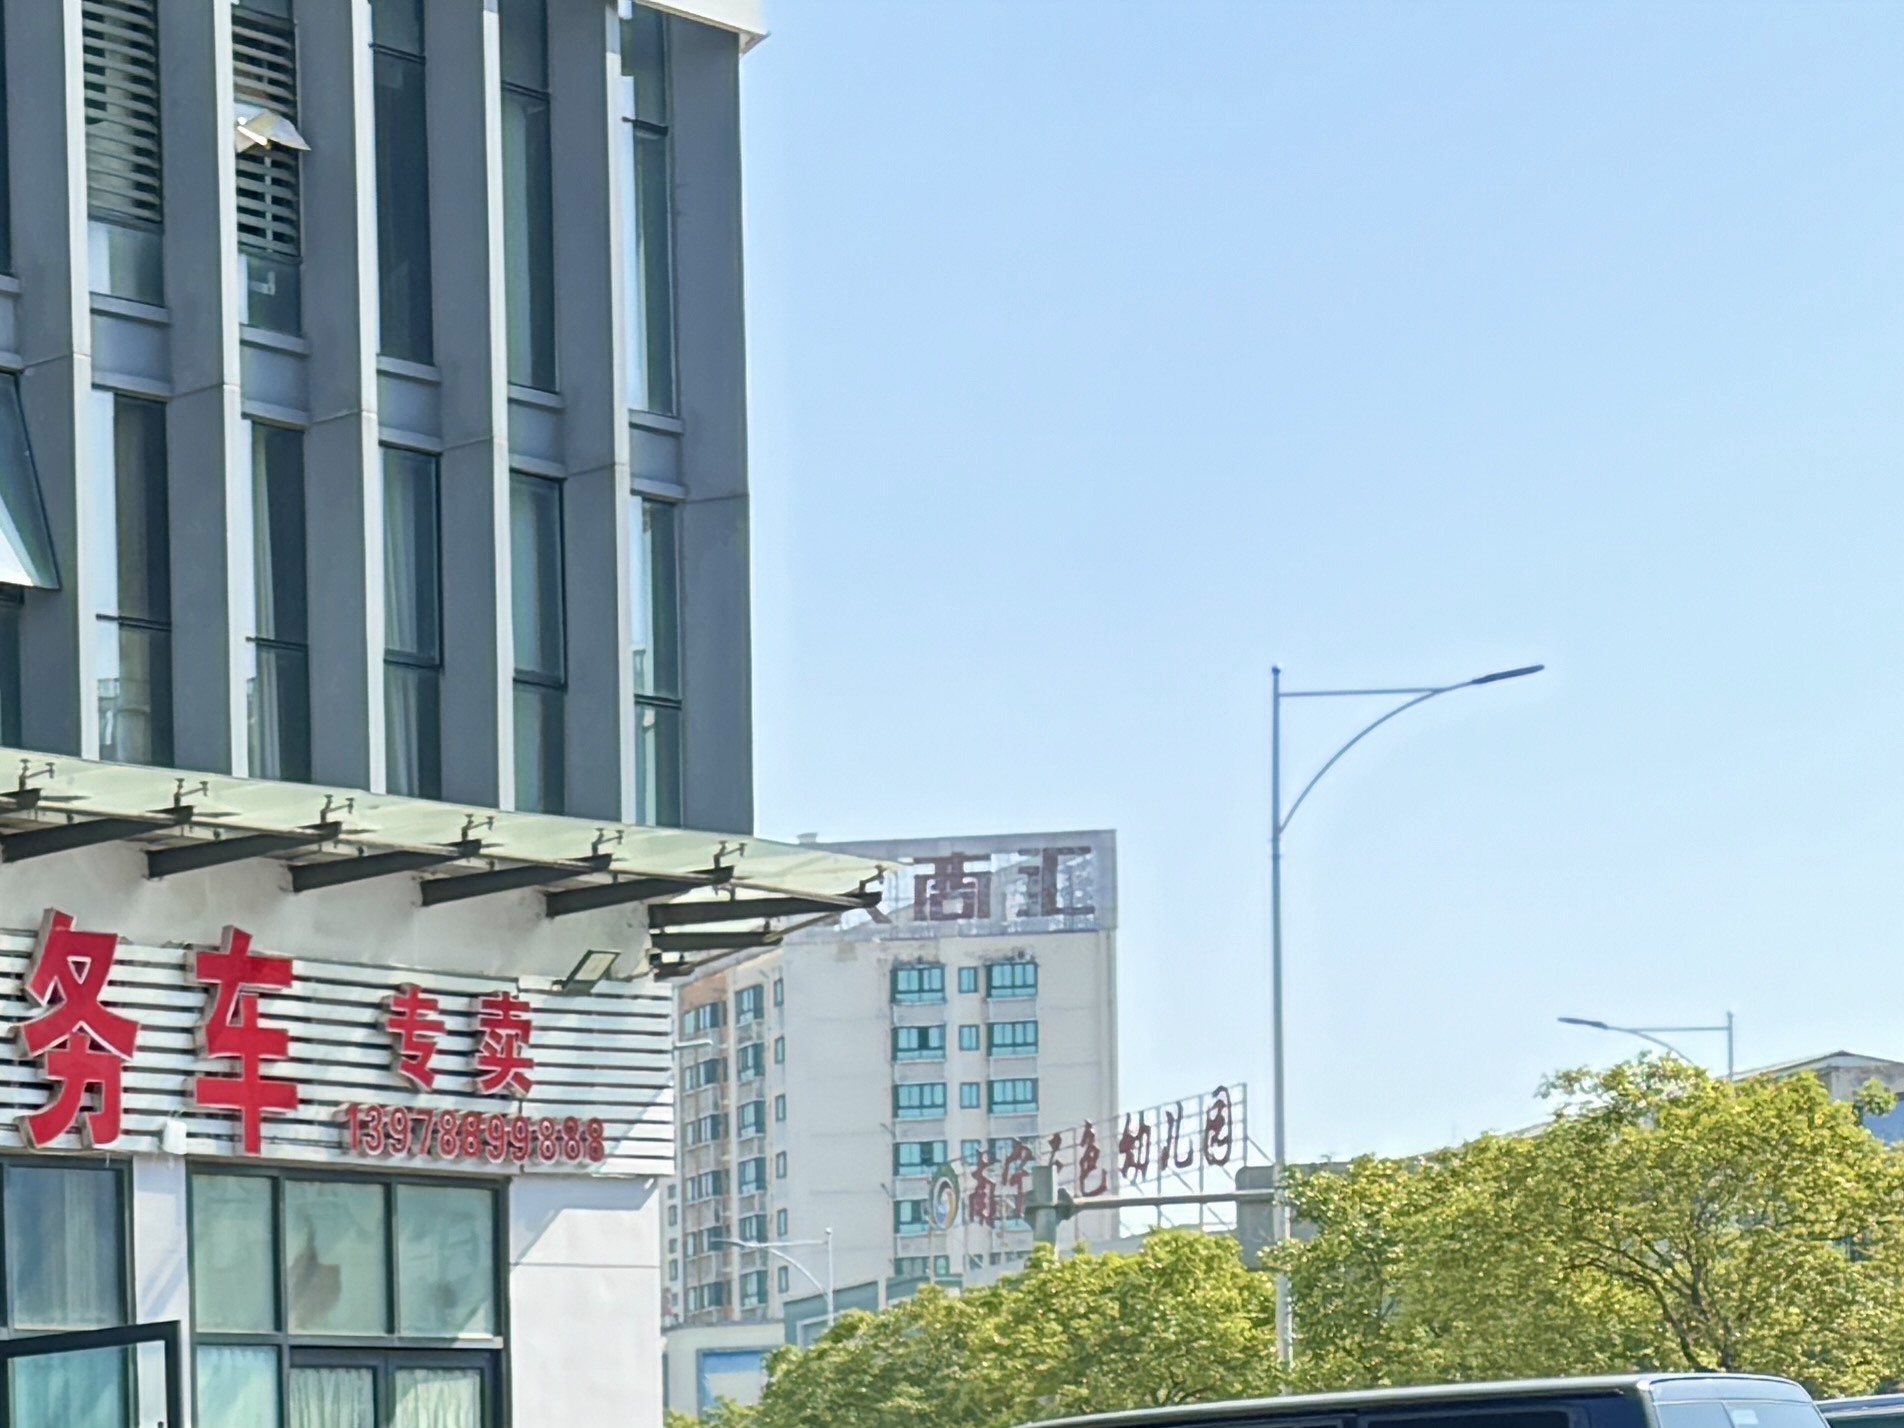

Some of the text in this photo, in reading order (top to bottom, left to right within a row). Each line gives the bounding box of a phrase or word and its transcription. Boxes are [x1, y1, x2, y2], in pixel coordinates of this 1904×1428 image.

[864, 846, 1096, 924] 商汇
[383, 982, 536, 1097] 专卖
[344, 1102, 605, 1164] 13978899888
